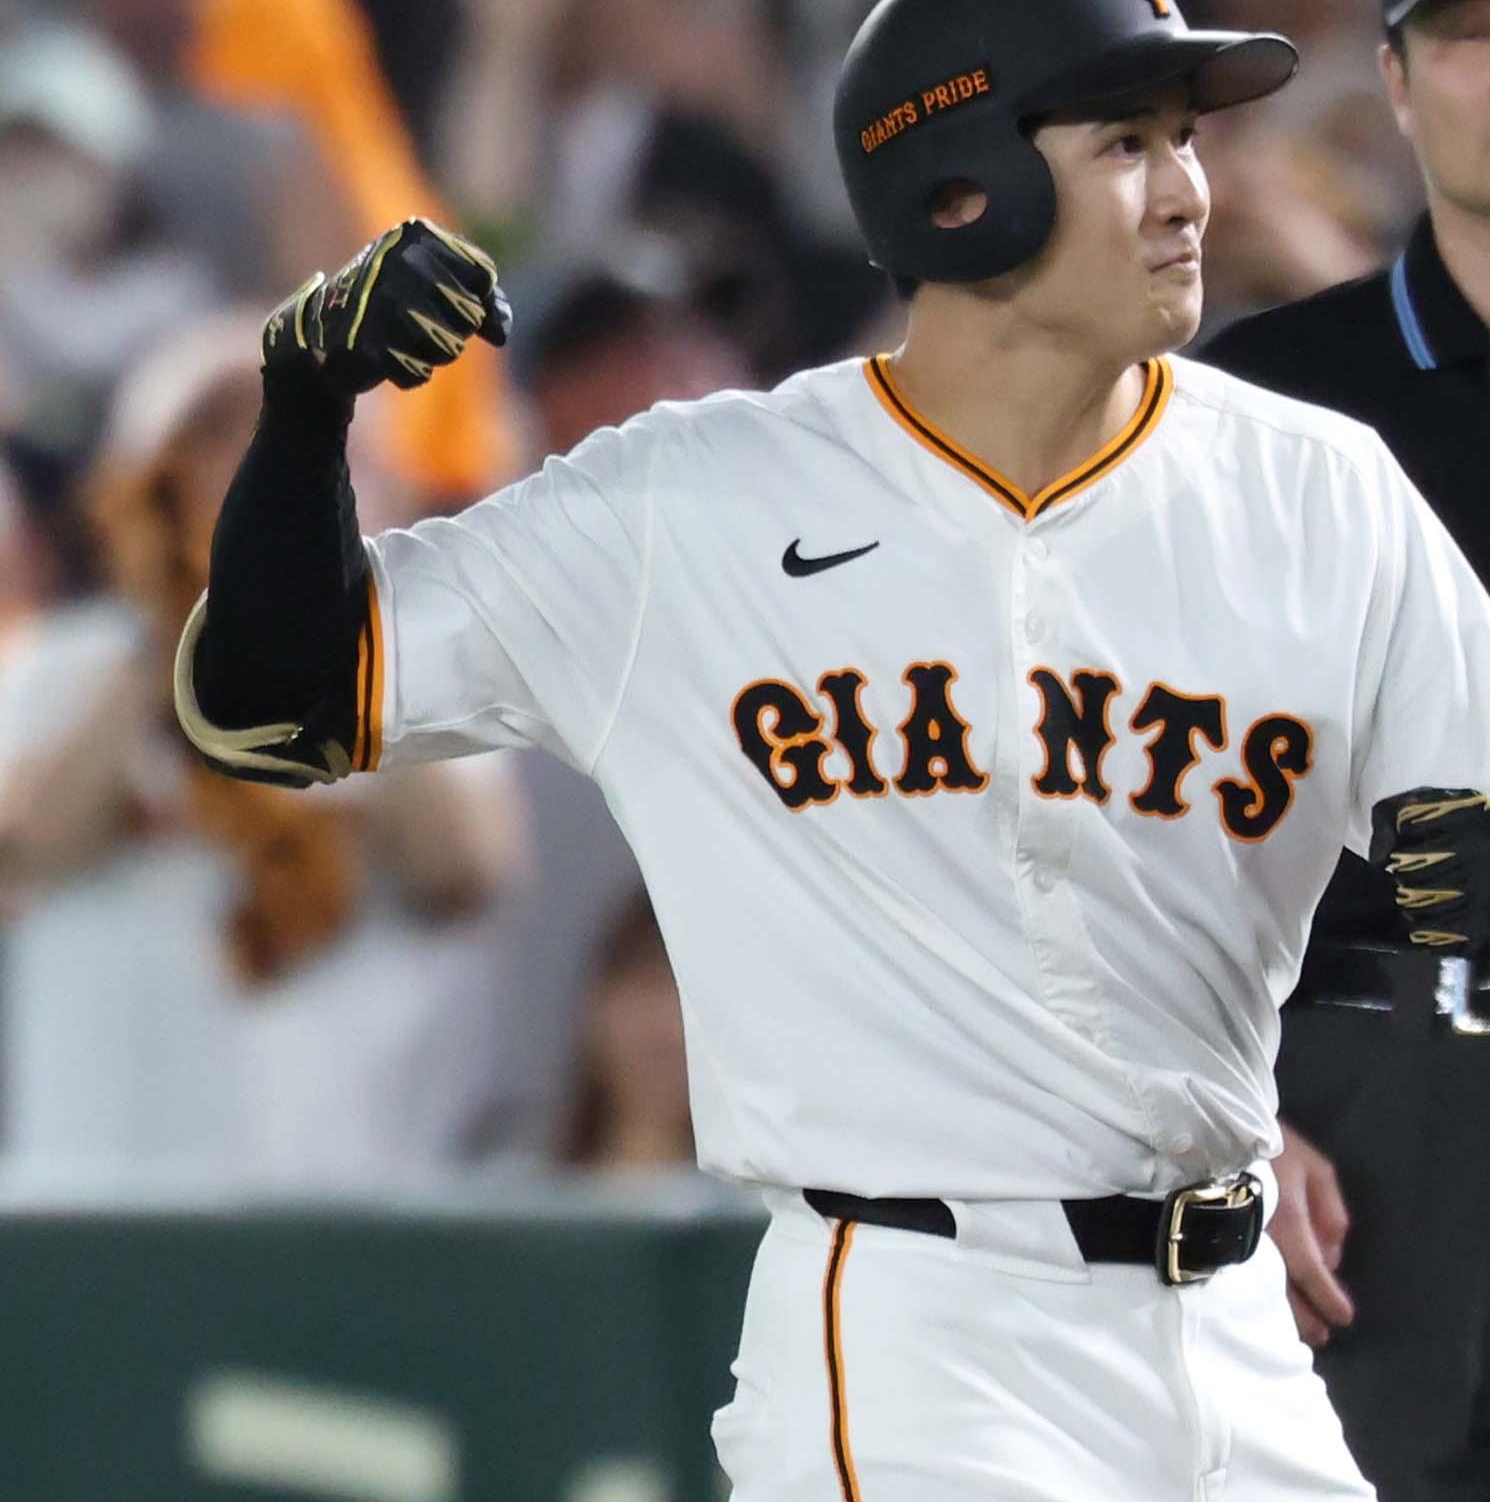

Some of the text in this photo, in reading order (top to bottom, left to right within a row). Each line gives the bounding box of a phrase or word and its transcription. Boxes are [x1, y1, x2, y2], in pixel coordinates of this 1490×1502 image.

[861, 68, 990, 154] GIANTS PRIDE
[731, 660, 1315, 844] GIANTS
